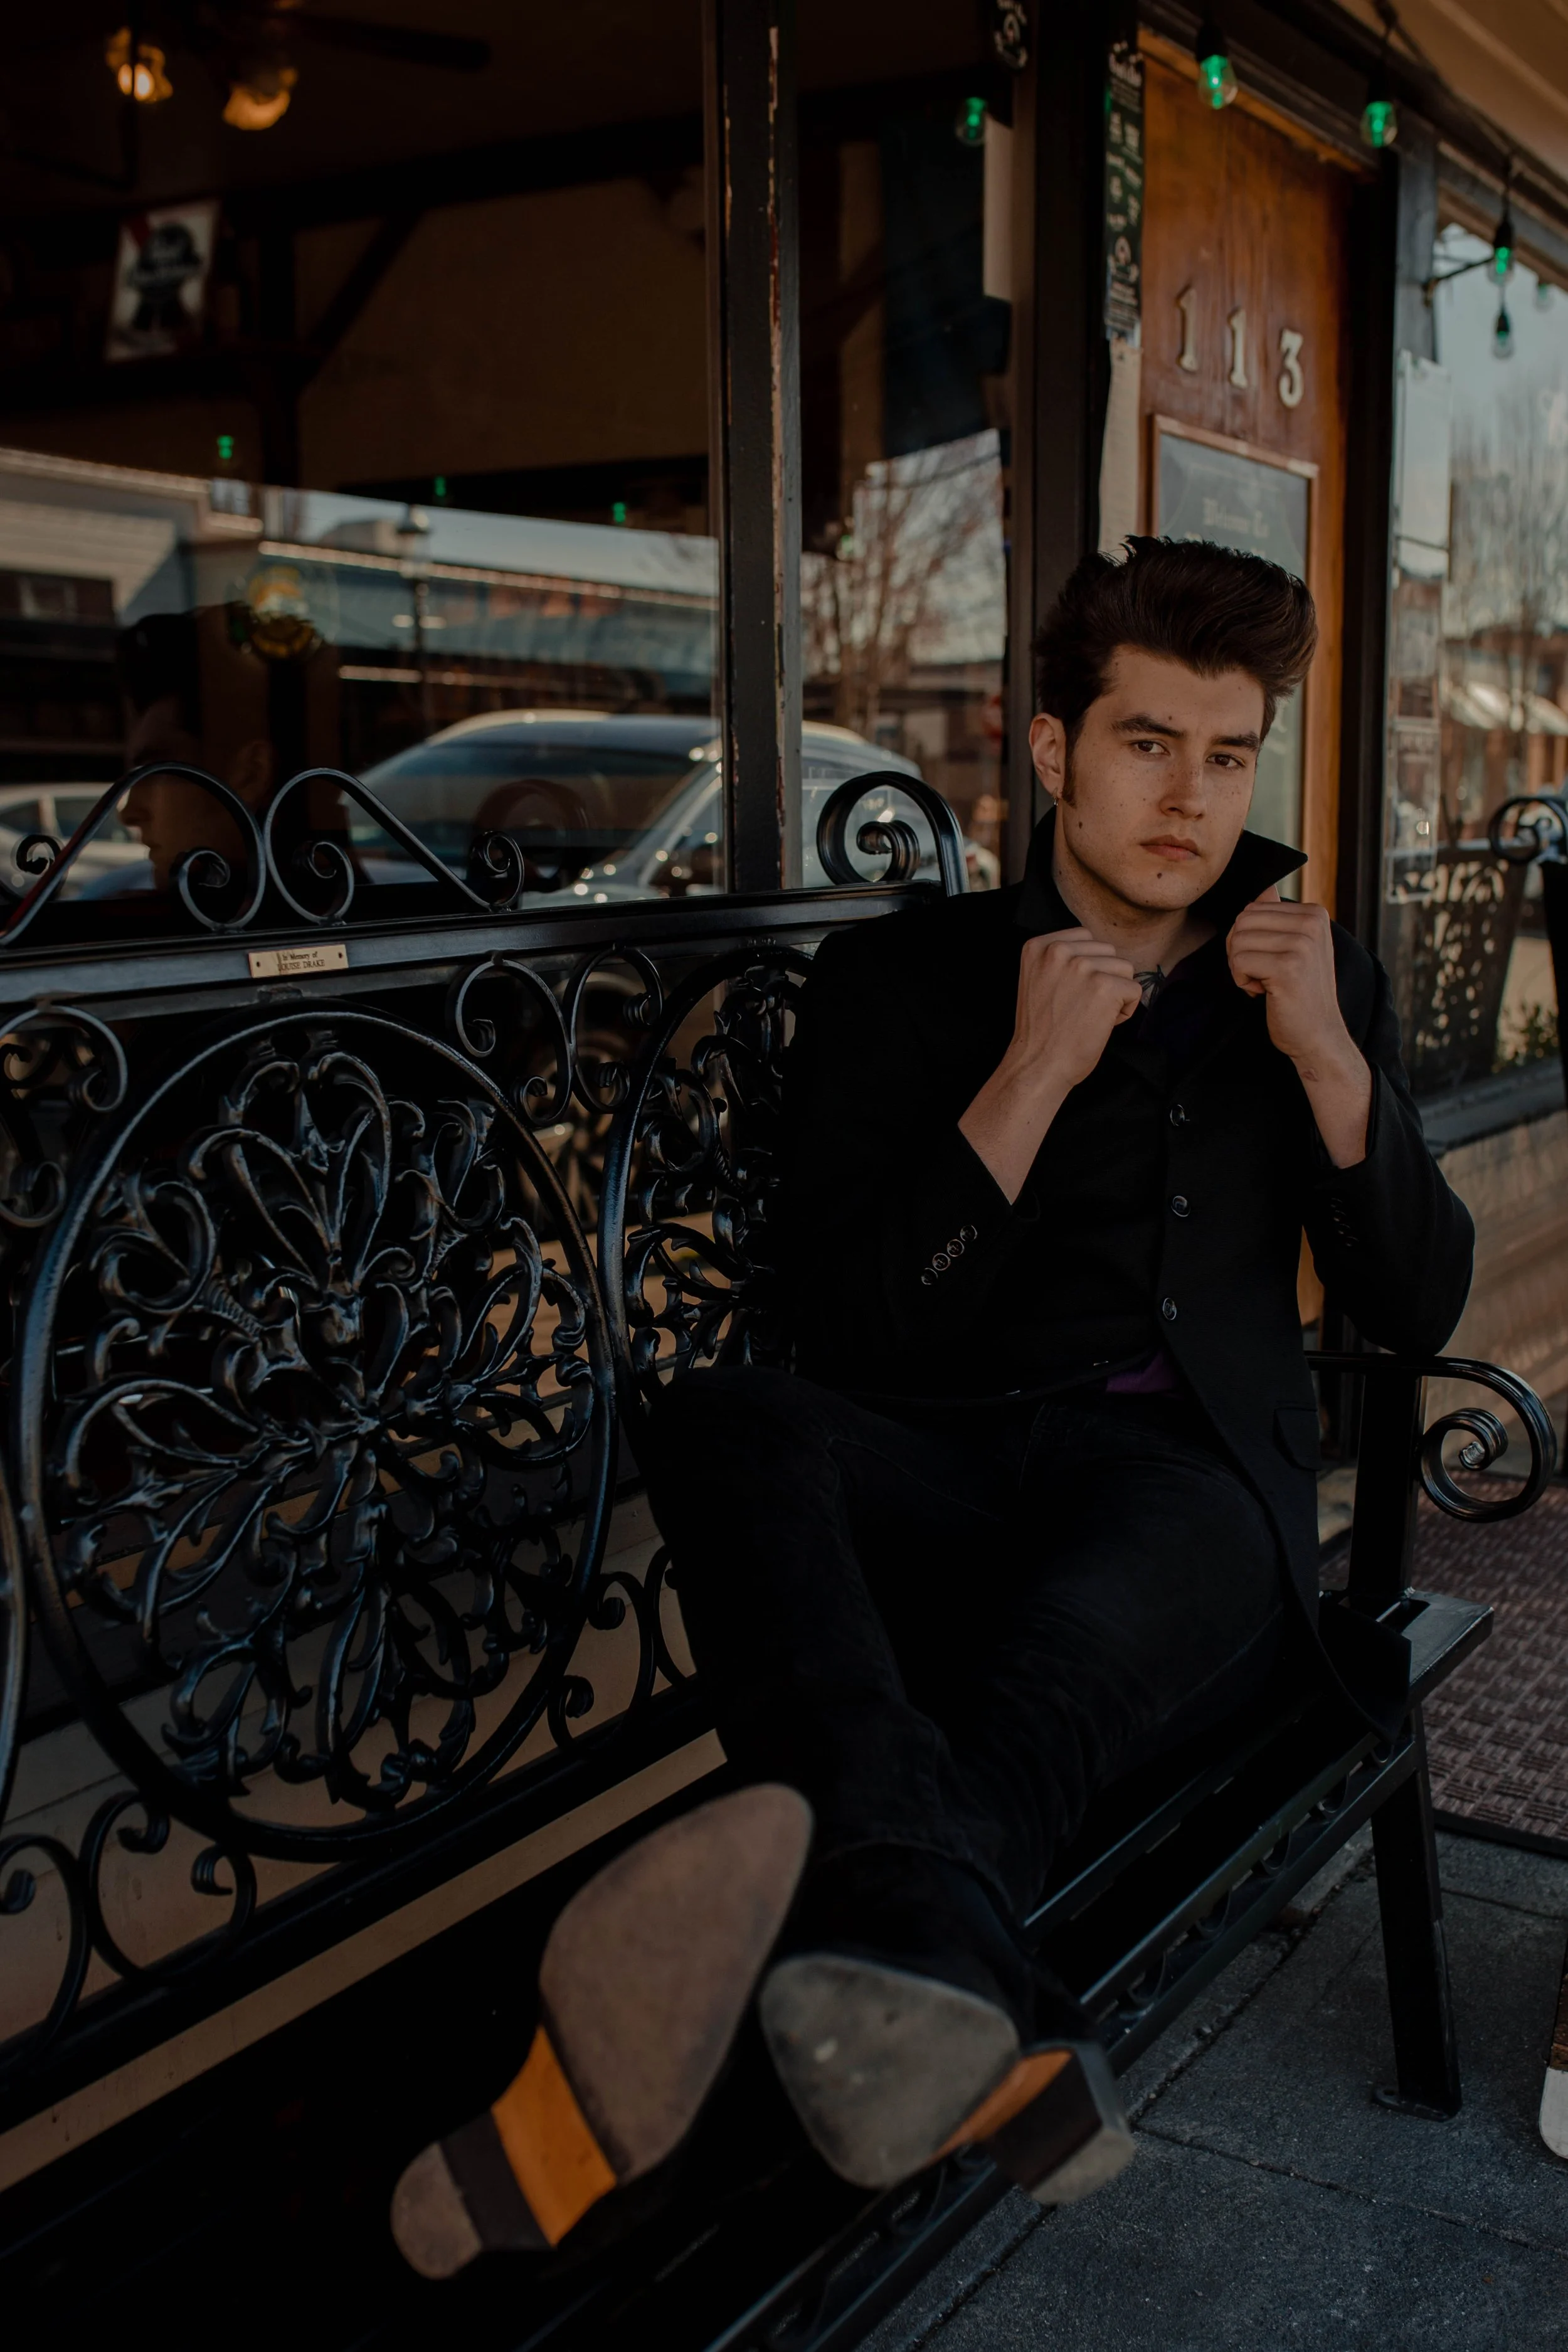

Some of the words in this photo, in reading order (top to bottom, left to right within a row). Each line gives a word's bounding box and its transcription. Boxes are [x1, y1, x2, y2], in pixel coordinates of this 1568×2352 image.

[1175, 285, 1304, 409] 113
[290, 953, 310, 961] Memory
[303, 959, 325, 968] DRAKE
